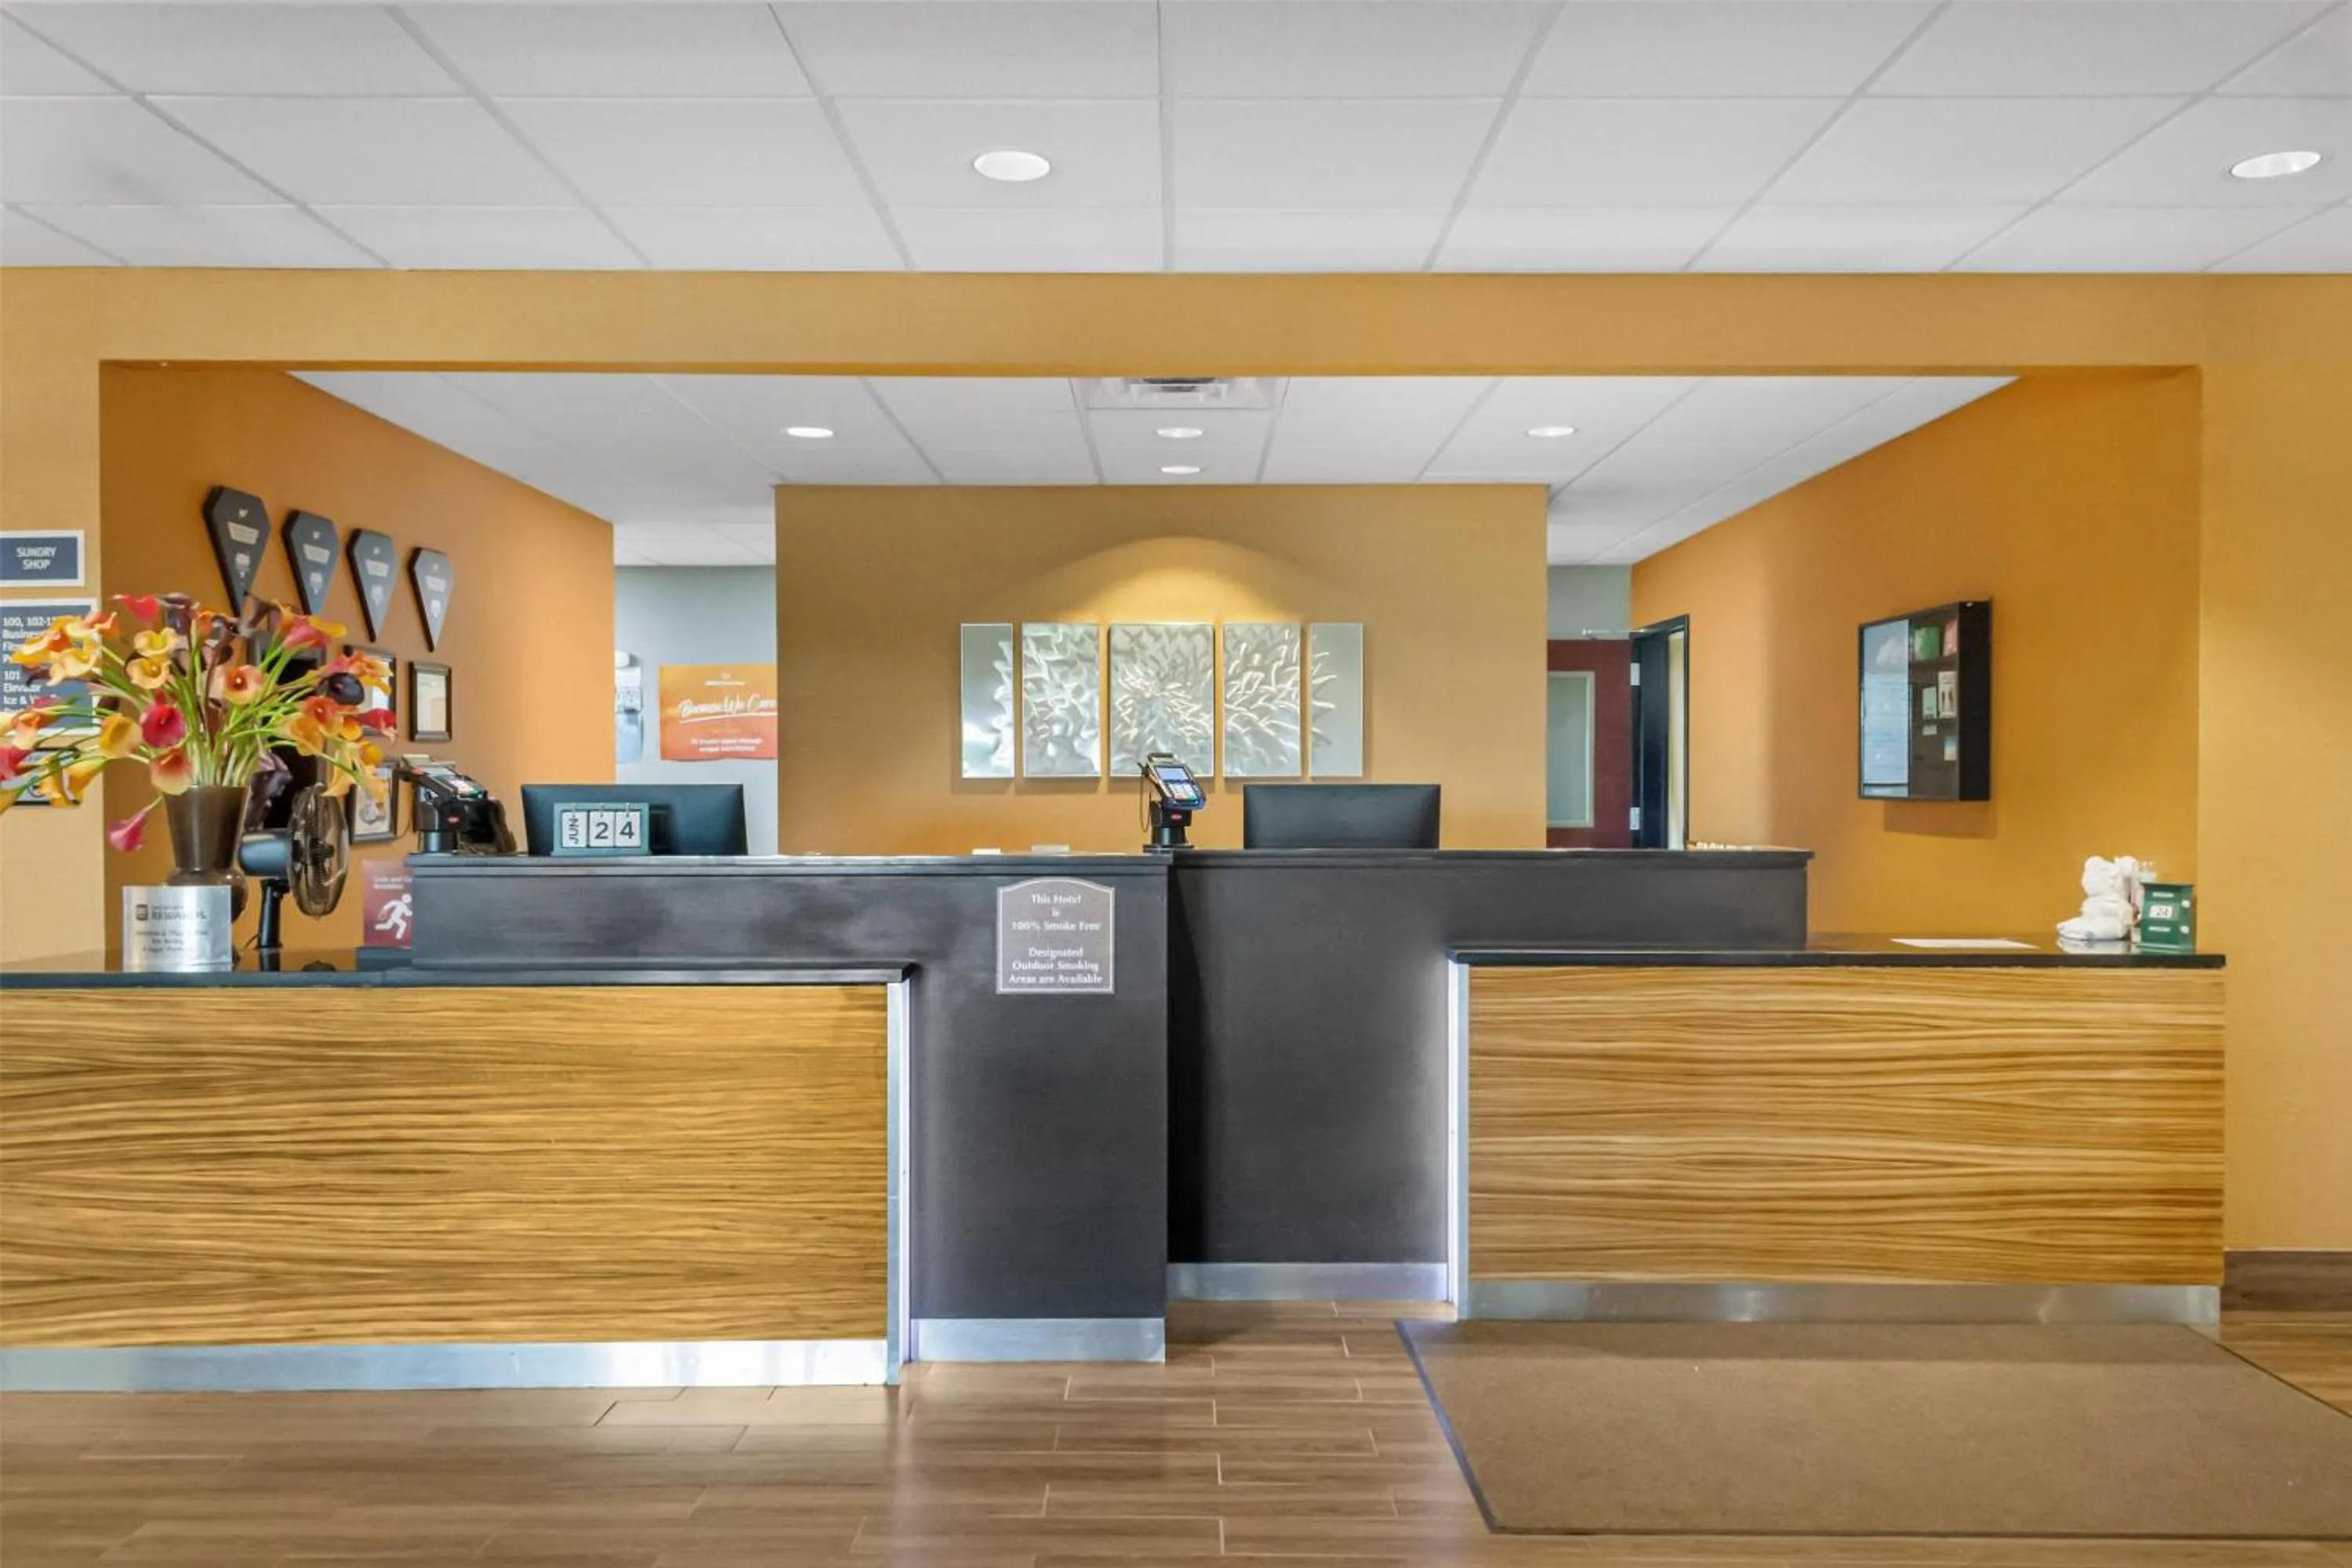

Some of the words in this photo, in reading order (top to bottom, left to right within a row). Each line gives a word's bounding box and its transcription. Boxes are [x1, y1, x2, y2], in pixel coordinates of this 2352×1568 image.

[16, 546, 57, 558] SUNDRY
[22, 558, 51, 571] SHOP
[3, 670, 20, 681] 101
[568, 817, 579, 845] JUN
[1031, 894, 1051, 904] This
[1054, 894, 1082, 904] Hotel
[151, 910, 207, 920] REWADS
[1051, 907, 1060, 917] is
[1011, 920, 1040, 931] 100%
[1044, 920, 1077, 931] Smoke
[1079, 920, 1102, 931] Free
[1028, 946, 1083, 960] Designated
[1011, 960, 1054, 971] Outdoor
[1057, 960, 1100, 972] Smoking
[1008, 974, 1037, 984] Areas
[1039, 975, 1055, 984] are
[1057, 974, 1103, 984] Available
